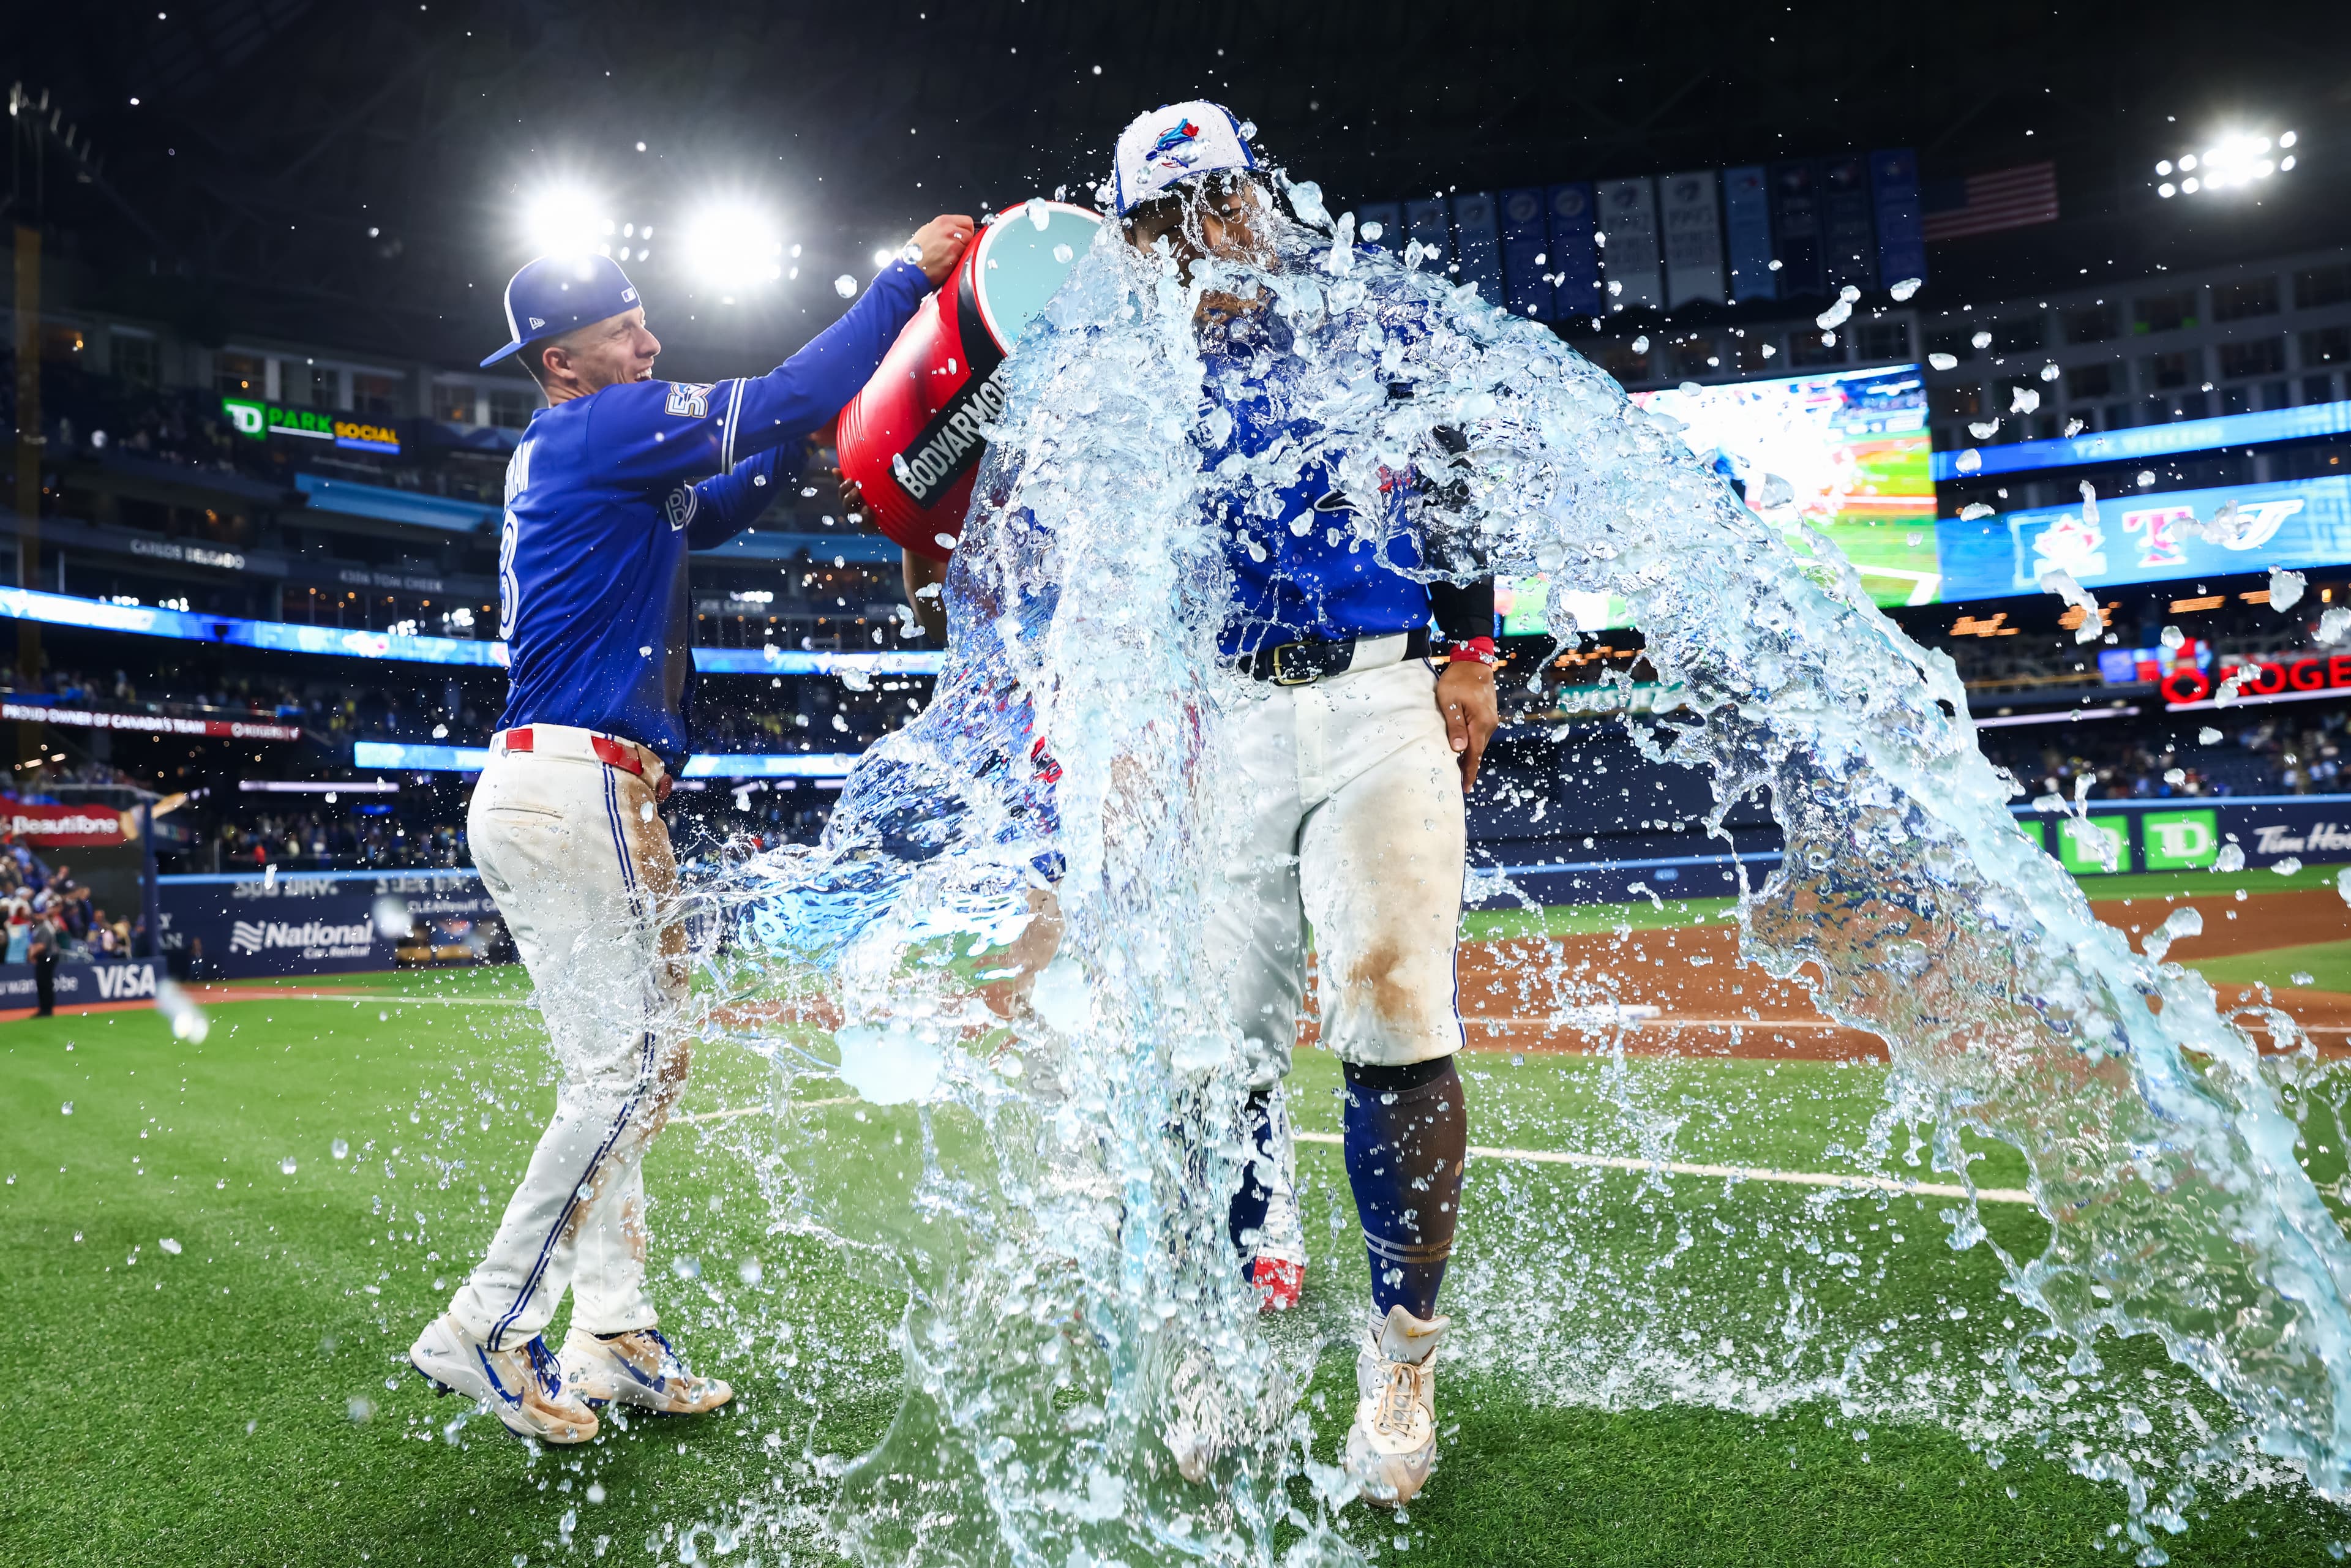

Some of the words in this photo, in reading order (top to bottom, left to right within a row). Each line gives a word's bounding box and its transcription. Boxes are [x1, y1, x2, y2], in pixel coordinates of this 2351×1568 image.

[224, 403, 263, 433] TD
[269, 407, 333, 433] PARK
[335, 421, 400, 445] SOCIAL
[130, 539, 182, 560] CARLOS
[185, 547, 245, 570] DELGADO
[2, 704, 47, 721] PROUD
[48, 708, 92, 726] OWNER
[93, 713, 110, 727] OF
[111, 715, 173, 732] CANADA'S
[174, 719, 206, 734] TEAM
[2149, 821, 2210, 858] TD
[2253, 825, 2304, 855] Tim
[264, 920, 374, 948] National
[91, 964, 157, 999] VISA
